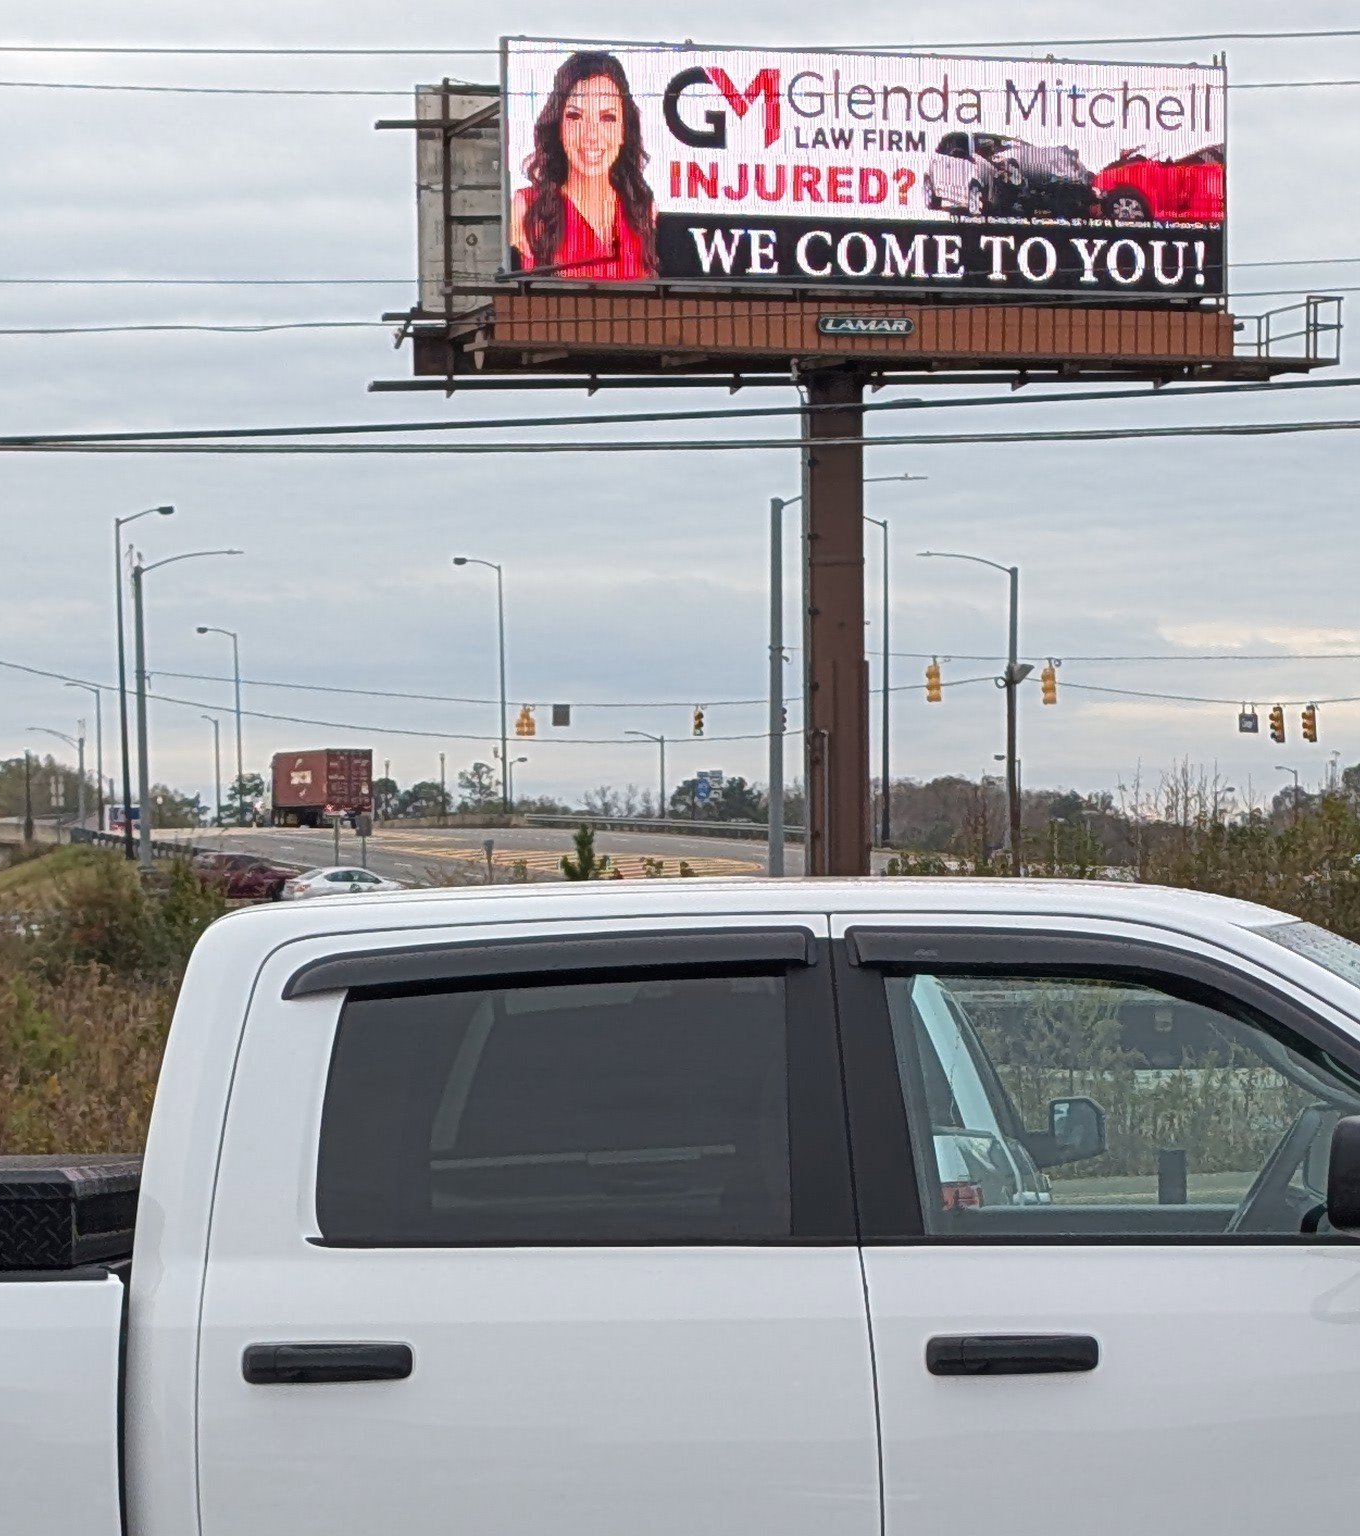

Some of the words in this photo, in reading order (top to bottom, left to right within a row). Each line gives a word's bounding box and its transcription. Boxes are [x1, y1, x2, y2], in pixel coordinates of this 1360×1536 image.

[662, 66, 780, 149] GM
[787, 67, 981, 125] Glenda
[1006, 77, 1212, 132] Mitchell
[794, 125, 854, 150] LAW
[862, 128, 927, 153] FIRM
[669, 160, 916, 205] INJURED?
[688, 227, 779, 275] WE
[795, 230, 965, 279] COME
[980, 235, 1058, 282] TO
[1070, 238, 1206, 286] YOU!
[825, 319, 908, 332] LAMAR
